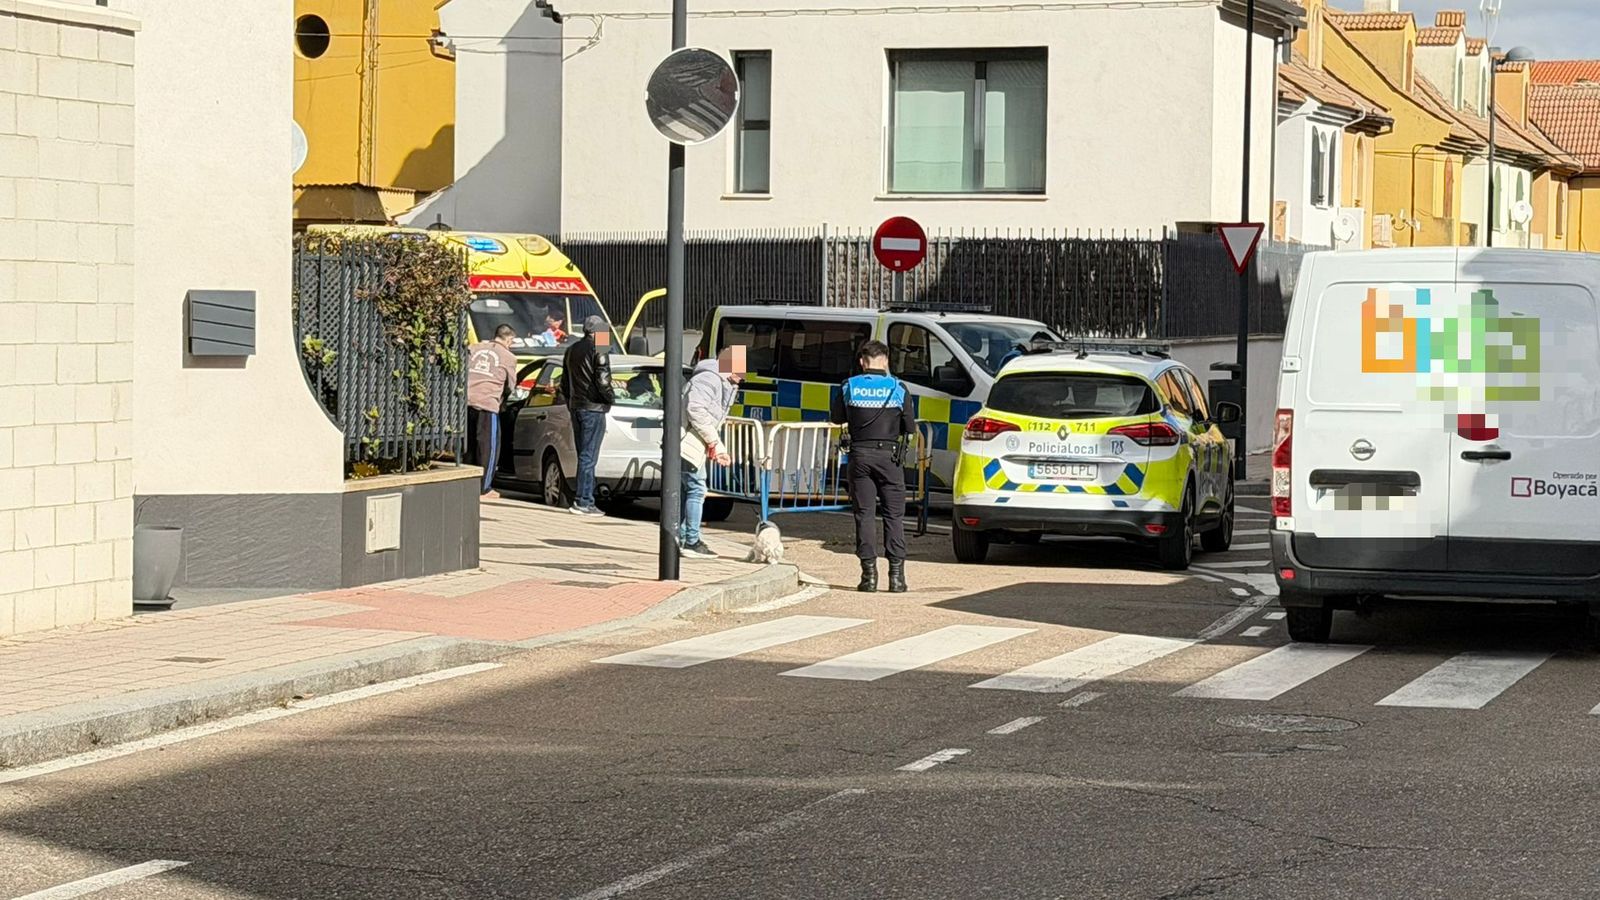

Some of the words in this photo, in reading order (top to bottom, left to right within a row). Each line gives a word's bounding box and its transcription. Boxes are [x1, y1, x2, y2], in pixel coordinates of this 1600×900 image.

[479, 279, 581, 291] AMBULANCIA
[1076, 422, 1096, 431] 711
[1036, 463, 1067, 476] 5650
[1071, 465, 1094, 477] LPL
[1534, 480, 1598, 500] Boyacá
